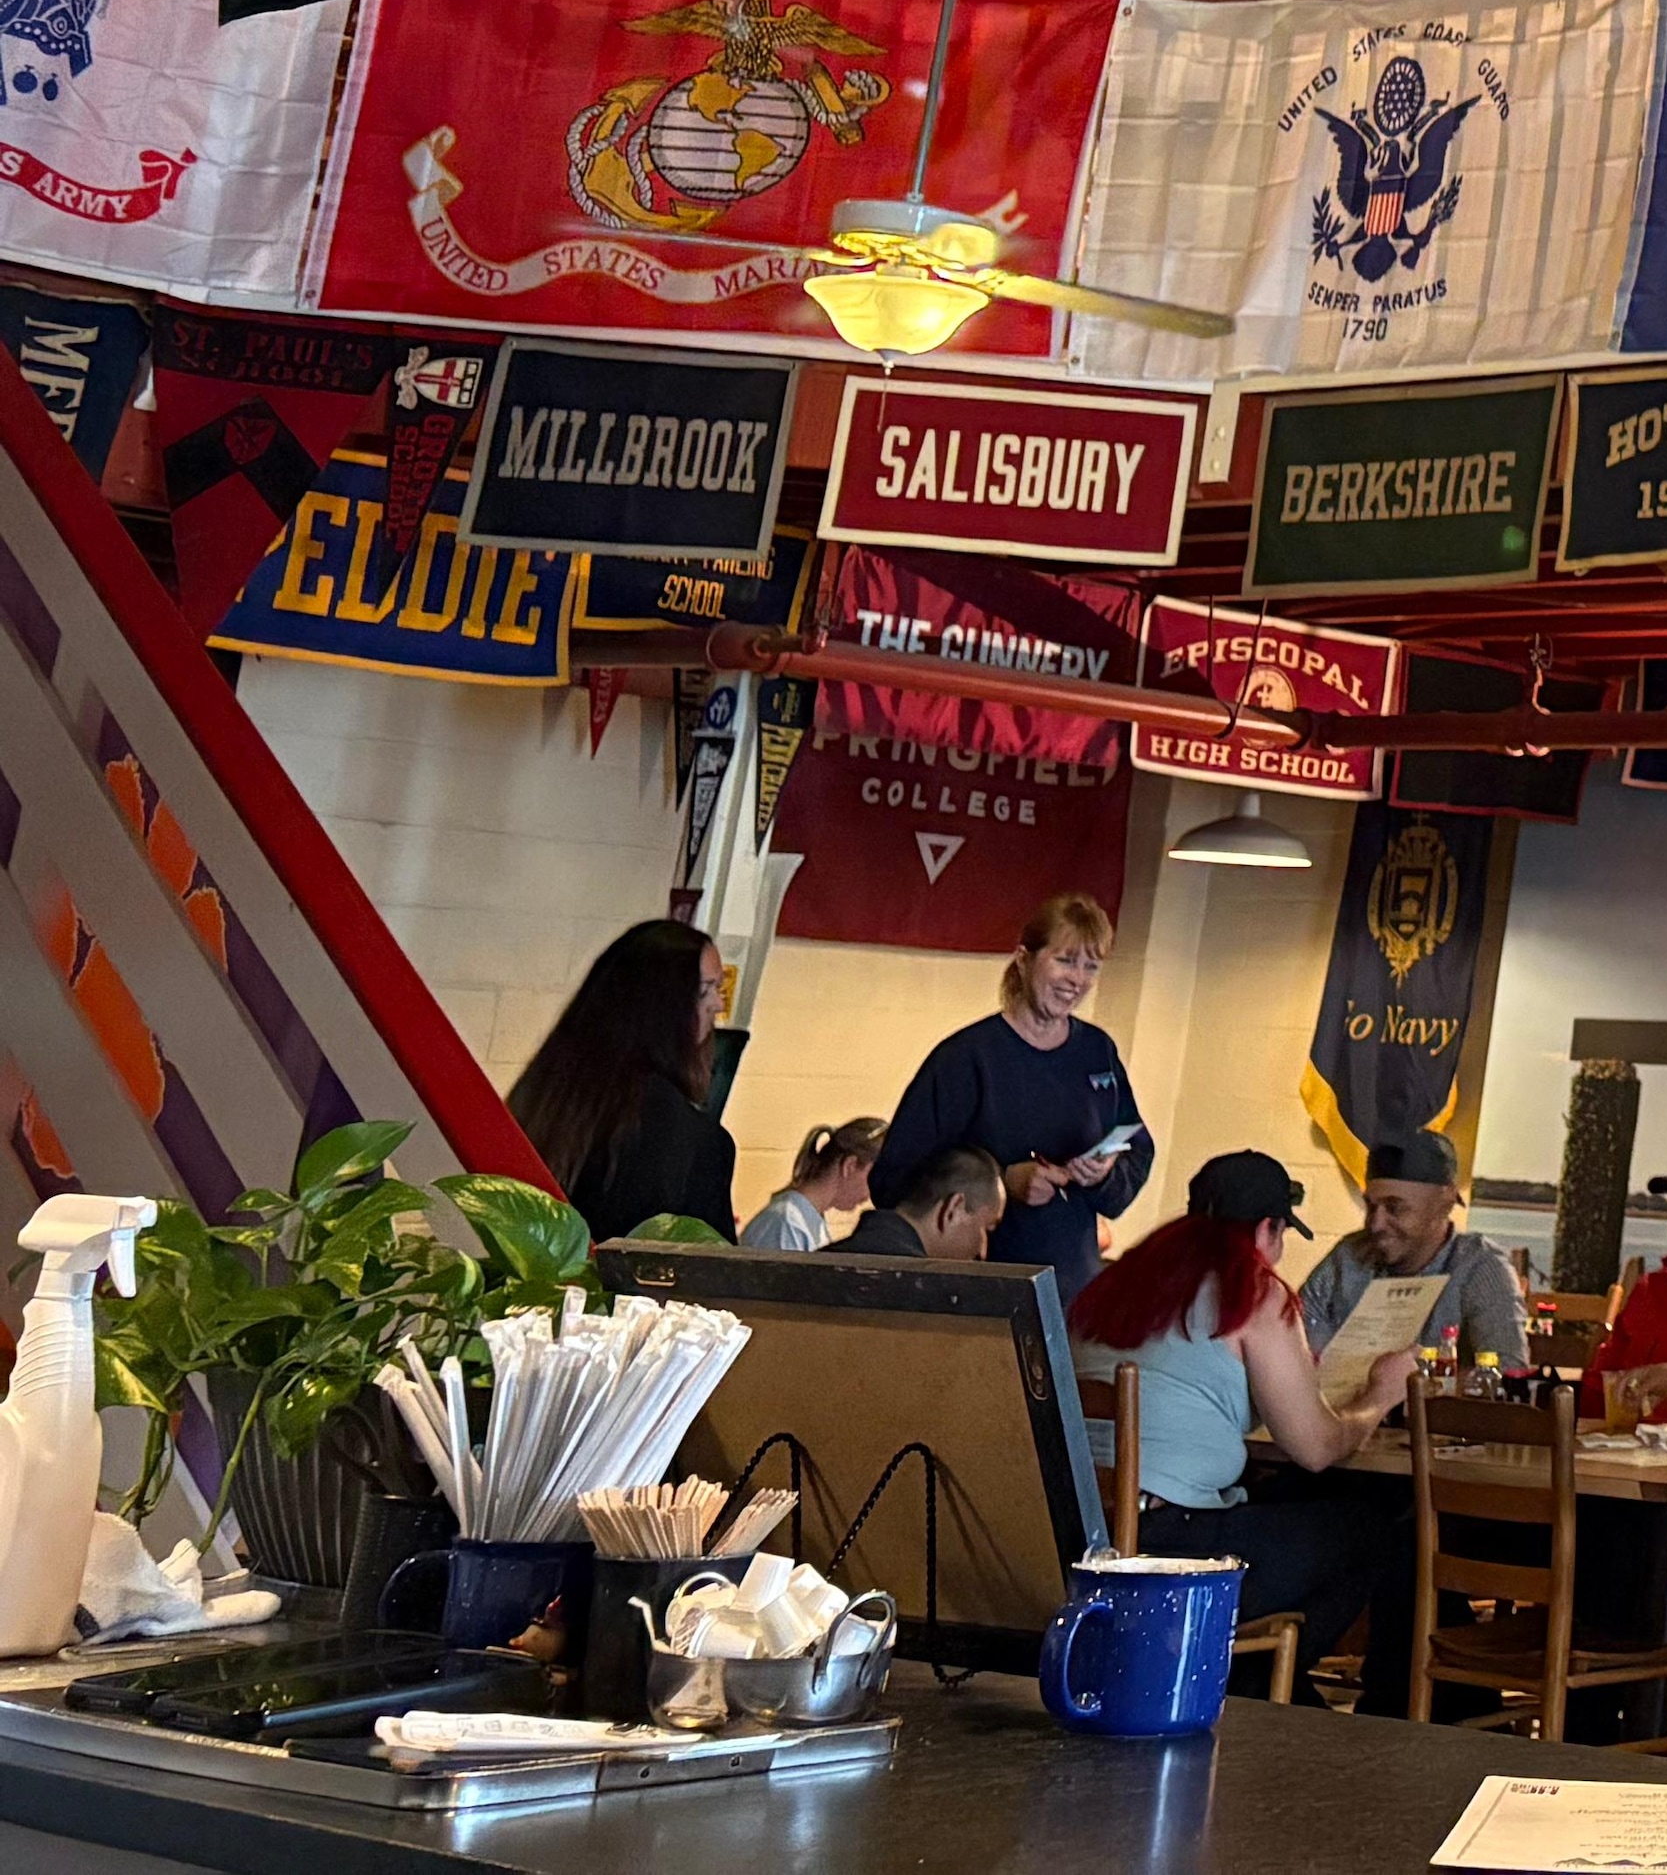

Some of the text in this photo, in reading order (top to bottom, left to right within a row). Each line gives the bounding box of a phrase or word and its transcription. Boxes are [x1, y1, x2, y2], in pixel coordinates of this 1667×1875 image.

[1277, 66, 1338, 132] UNITED
[1353, 24, 1406, 62] STATES
[1477, 58, 1509, 122] GUARD
[34, 175, 131, 218] ARMY
[420, 216, 508, 292] UNITED
[542, 244, 665, 291] STATES
[1308, 279, 1447, 313] SEMPER PARATUS
[1343, 318, 1388, 341] 1790
[500, 406, 768, 494] MILLBROOK
[875, 425, 1145, 516] SALISBURY
[1280, 451, 1516, 523] BERKSHIRE
[236, 492, 556, 645] EDDIE
[657, 574, 726, 620] SCHOOL
[857, 608, 931, 654] THE
[1159, 637, 1370, 711] EPISCOPAL
[1150, 735, 1356, 785] HIGH SCHOOL
[861, 777, 1037, 826] COLLEGE
[1345, 1000, 1459, 1056] o Navy
